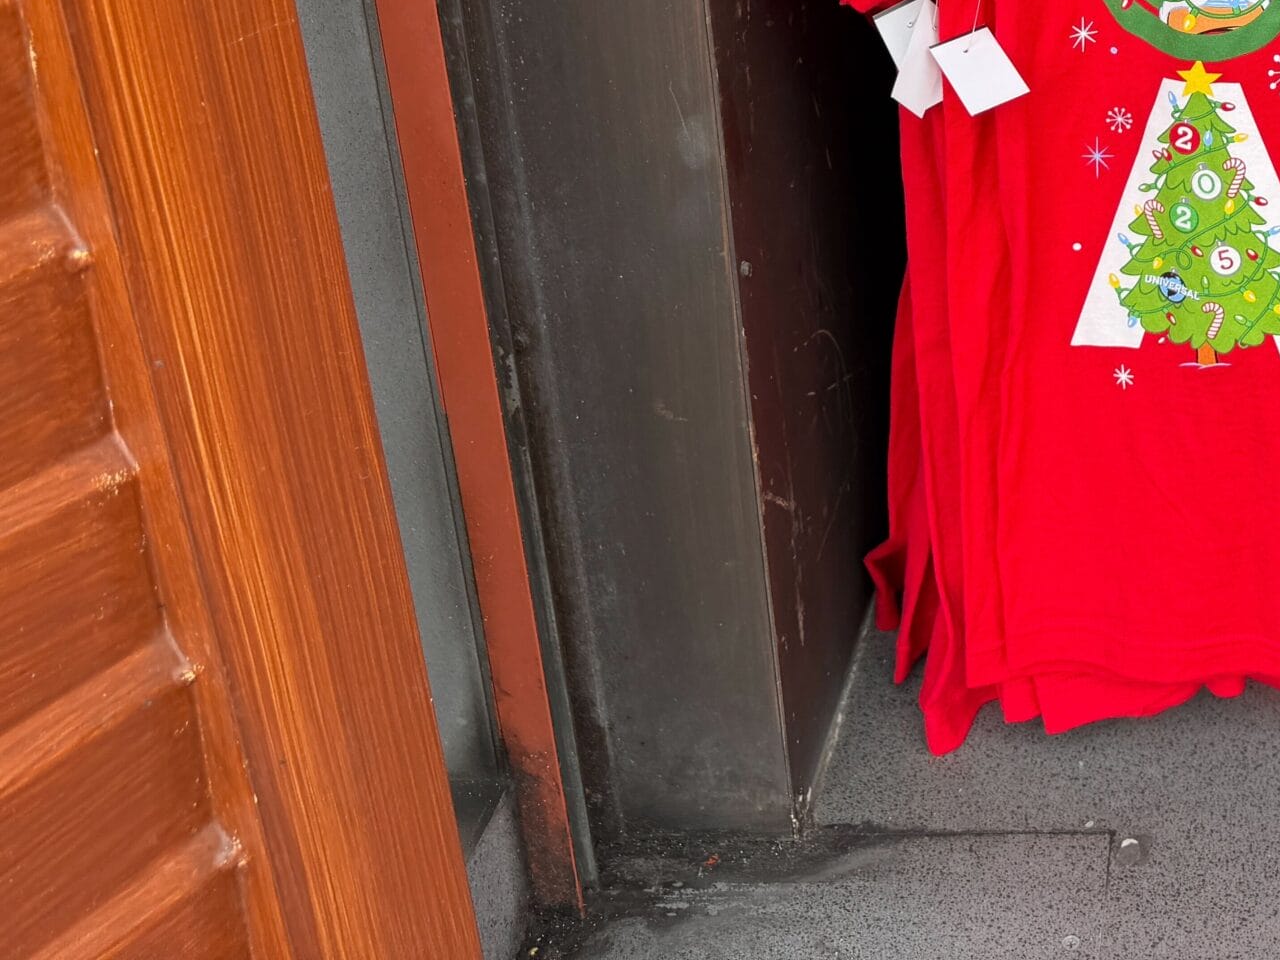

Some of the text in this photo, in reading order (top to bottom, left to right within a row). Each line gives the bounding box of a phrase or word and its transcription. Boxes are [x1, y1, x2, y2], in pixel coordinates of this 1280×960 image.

[1175, 125, 1193, 151] 2
[1176, 209, 1191, 230] 2
[1218, 249, 1234, 270] 5
[1144, 274, 1200, 301] UNIVERSAL
